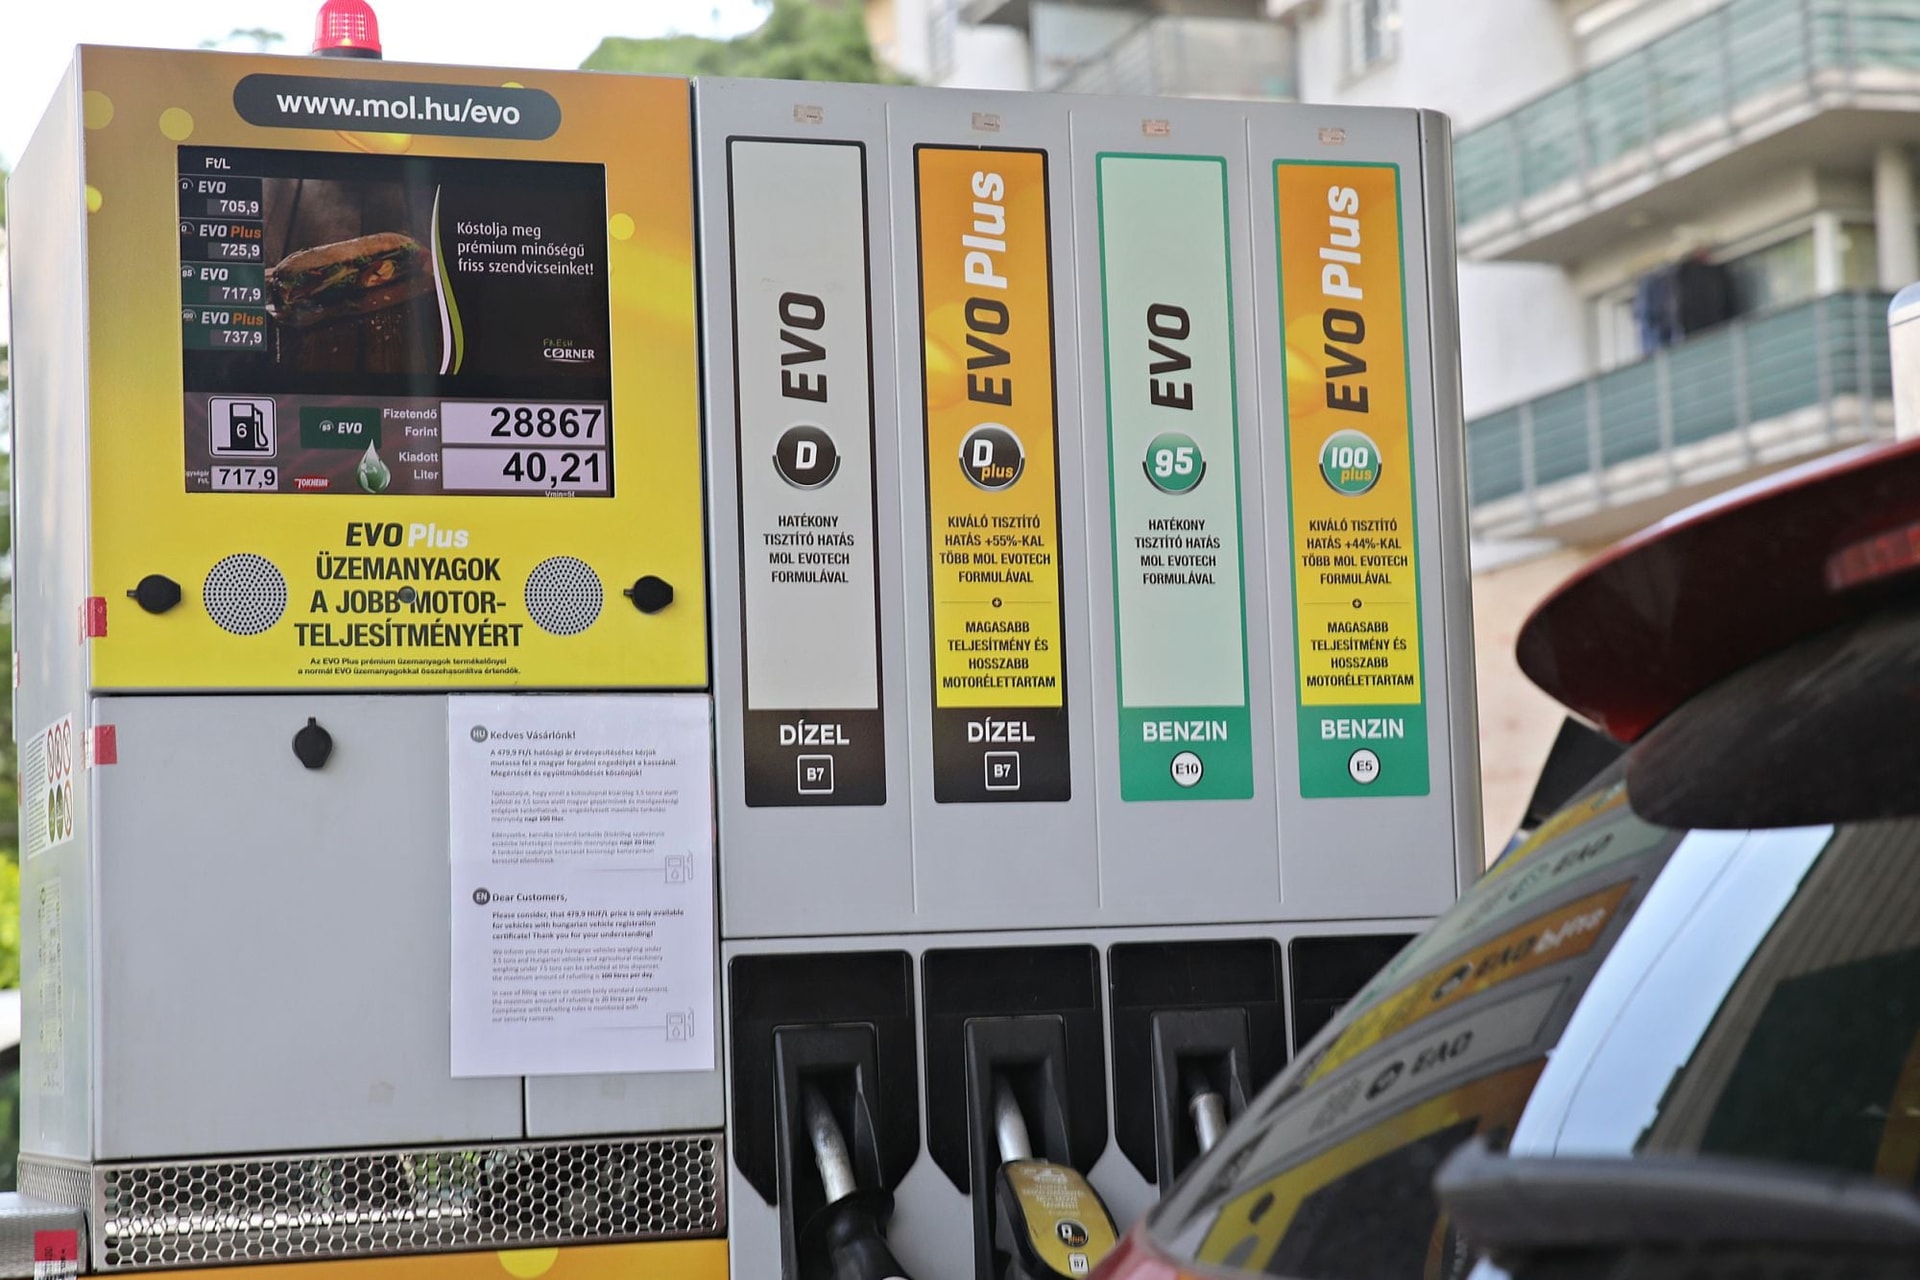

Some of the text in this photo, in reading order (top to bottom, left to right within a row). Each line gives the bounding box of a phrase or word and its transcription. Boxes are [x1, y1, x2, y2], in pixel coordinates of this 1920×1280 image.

[276, 93, 520, 125] www.mol.hu/evo
[205, 157, 231, 169] Ft/L
[198, 180, 227, 194] EVO
[220, 200, 259, 215] 705,9
[199, 224, 228, 237] EVO
[230, 225, 262, 240] Plus
[457, 221, 542, 240] Kóstolja meg
[221, 243, 260, 259] 725,9
[457, 240, 585, 260] prémium minőségű
[200, 267, 229, 281] EVO
[458, 258, 594, 276] friss szendvicseinket!
[222, 286, 261, 303] 717,9
[962, 171, 1012, 407] EVO Plus
[1319, 185, 1369, 413] EVO Plus
[201, 311, 230, 325] EVO
[232, 312, 264, 326] Plus
[223, 331, 263, 346] 737,9
[543, 347, 595, 360] CORNER
[778, 291, 828, 403] EVO
[1147, 303, 1193, 410] EVO
[337, 421, 363, 435] EVO
[383, 406, 602, 438] Fizetendő 28867
[236, 422, 248, 438] 6
[404, 426, 438, 438] Forint
[795, 440, 817, 469] D
[972, 439, 993, 467] D
[1331, 446, 1369, 468] 100
[1154, 447, 1194, 476] 95
[398, 451, 599, 488] Kiadott 40,21
[413, 470, 439, 481] Liter
[981, 464, 1013, 480] plus
[1340, 467, 1372, 484] plus
[218, 468, 276, 489] 717,9
[778, 514, 838, 528] HATÉKONY
[948, 514, 1040, 528] KIVÁLÓ TISZTÍTÓ
[1149, 518, 1205, 531] HATÉKONY
[1309, 518, 1397, 532] KIVÁLÓ TISZTÍTÓ
[346, 522, 469, 547] EVO Plus
[763, 532, 854, 546] TISZTÍTÓ HATÁS
[945, 532, 1044, 547] HATÁS +55%-KAL
[1135, 535, 1220, 549] TISZTÍTÓ HATÁS
[1307, 536, 1401, 550] HATÁS +44%-KAL
[769, 552, 850, 565] MOL EVOTECH
[939, 551, 1051, 565] TÖBB MOL EVOTECH
[1140, 555, 1216, 567] MOL EVOTECH
[1302, 554, 1408, 567] TÖBB MOL EVOTECH
[316, 551, 501, 581] ÜZEMANYAGOK
[771, 569, 849, 583] FORMULÁVAL
[958, 569, 1033, 583] FORMULÁVAL
[1143, 571, 1216, 585] FORMULÁVAL
[1320, 571, 1391, 584] FORMULÁVAL
[310, 590, 506, 614] A JOBB MOTOR-
[294, 618, 523, 647] TELJESÍTMÉNYÉRT
[966, 621, 1030, 633] MAGASABB
[1327, 621, 1388, 633] MAGASABB
[948, 637, 1048, 651] TELJESÍTMÉNY ÉS
[1311, 637, 1407, 651] TELJESÍTMÉNY ÉS
[322, 657, 340, 665] EVO
[360, 657, 396, 666] prémium
[969, 657, 1029, 669] HOSSZABB
[1331, 656, 1388, 668] HOSSZABB
[942, 674, 1056, 688] MOTORÉLETTARTAM
[1307, 672, 1414, 687] MOTORÉLETTARTAM
[490, 730, 524, 741] Kedves
[526, 730, 576, 741] Vásárlónk!
[780, 717, 850, 745] DÍZEL
[967, 717, 1035, 742] DÍZEL
[1143, 721, 1227, 742] BENZIN
[1321, 718, 1404, 740] BENZIN
[994, 764, 1010, 777] B7
[1176, 763, 1198, 775] E10
[1356, 760, 1372, 771] E5
[806, 767, 824, 781] B7
[476, 892, 568, 904] EN Dear Customers,
